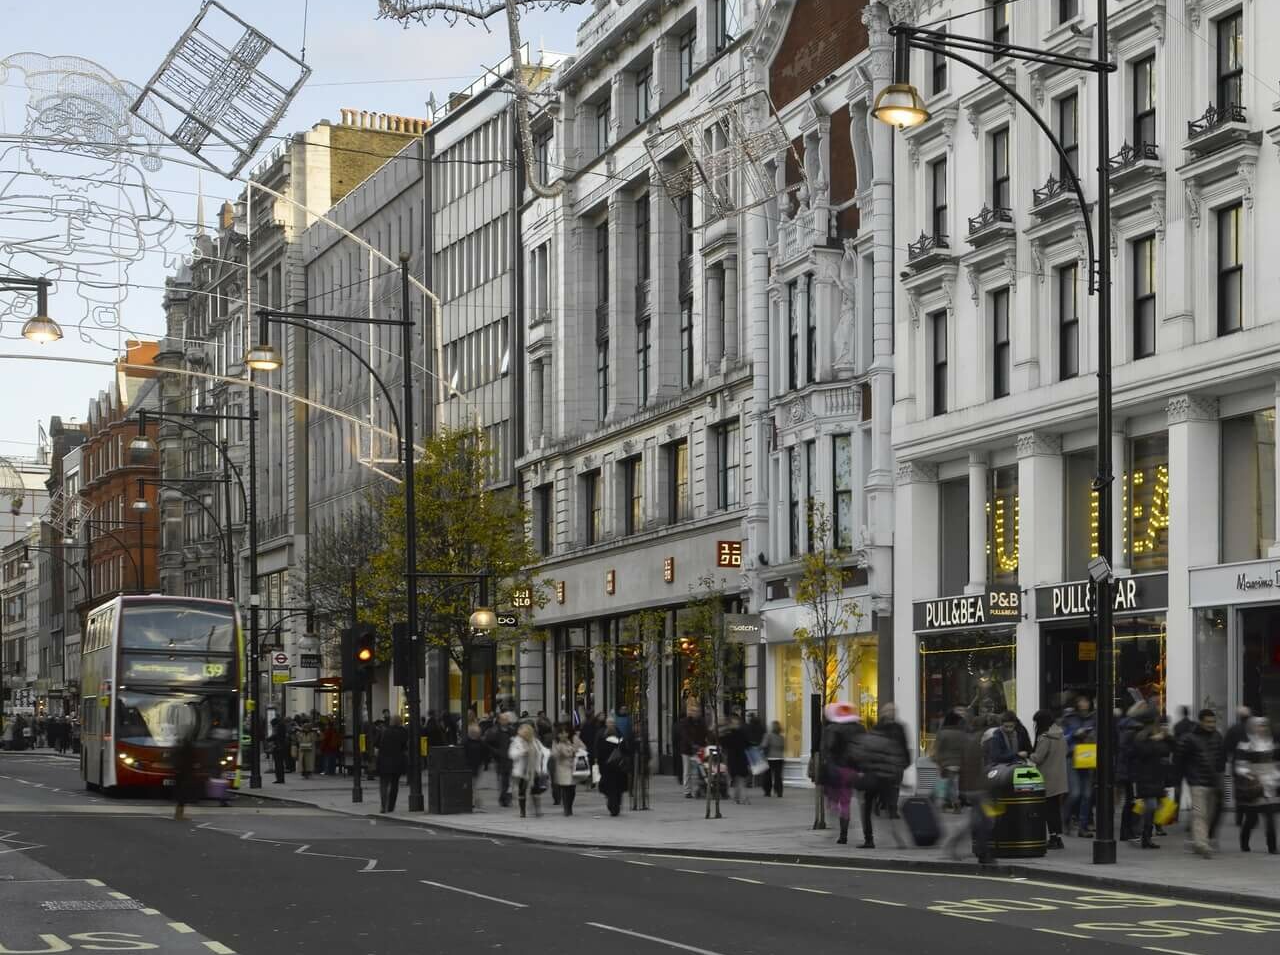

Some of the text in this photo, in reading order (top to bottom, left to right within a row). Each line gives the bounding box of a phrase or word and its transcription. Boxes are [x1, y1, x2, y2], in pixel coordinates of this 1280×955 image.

[1236, 573, 1274, 591] Massimo
[990, 592, 1019, 606] P&B
[1053, 579, 1136, 615] PULL&AR
[926, 596, 984, 628] PULL&BEA
[926, 895, 1178, 913] STOP
